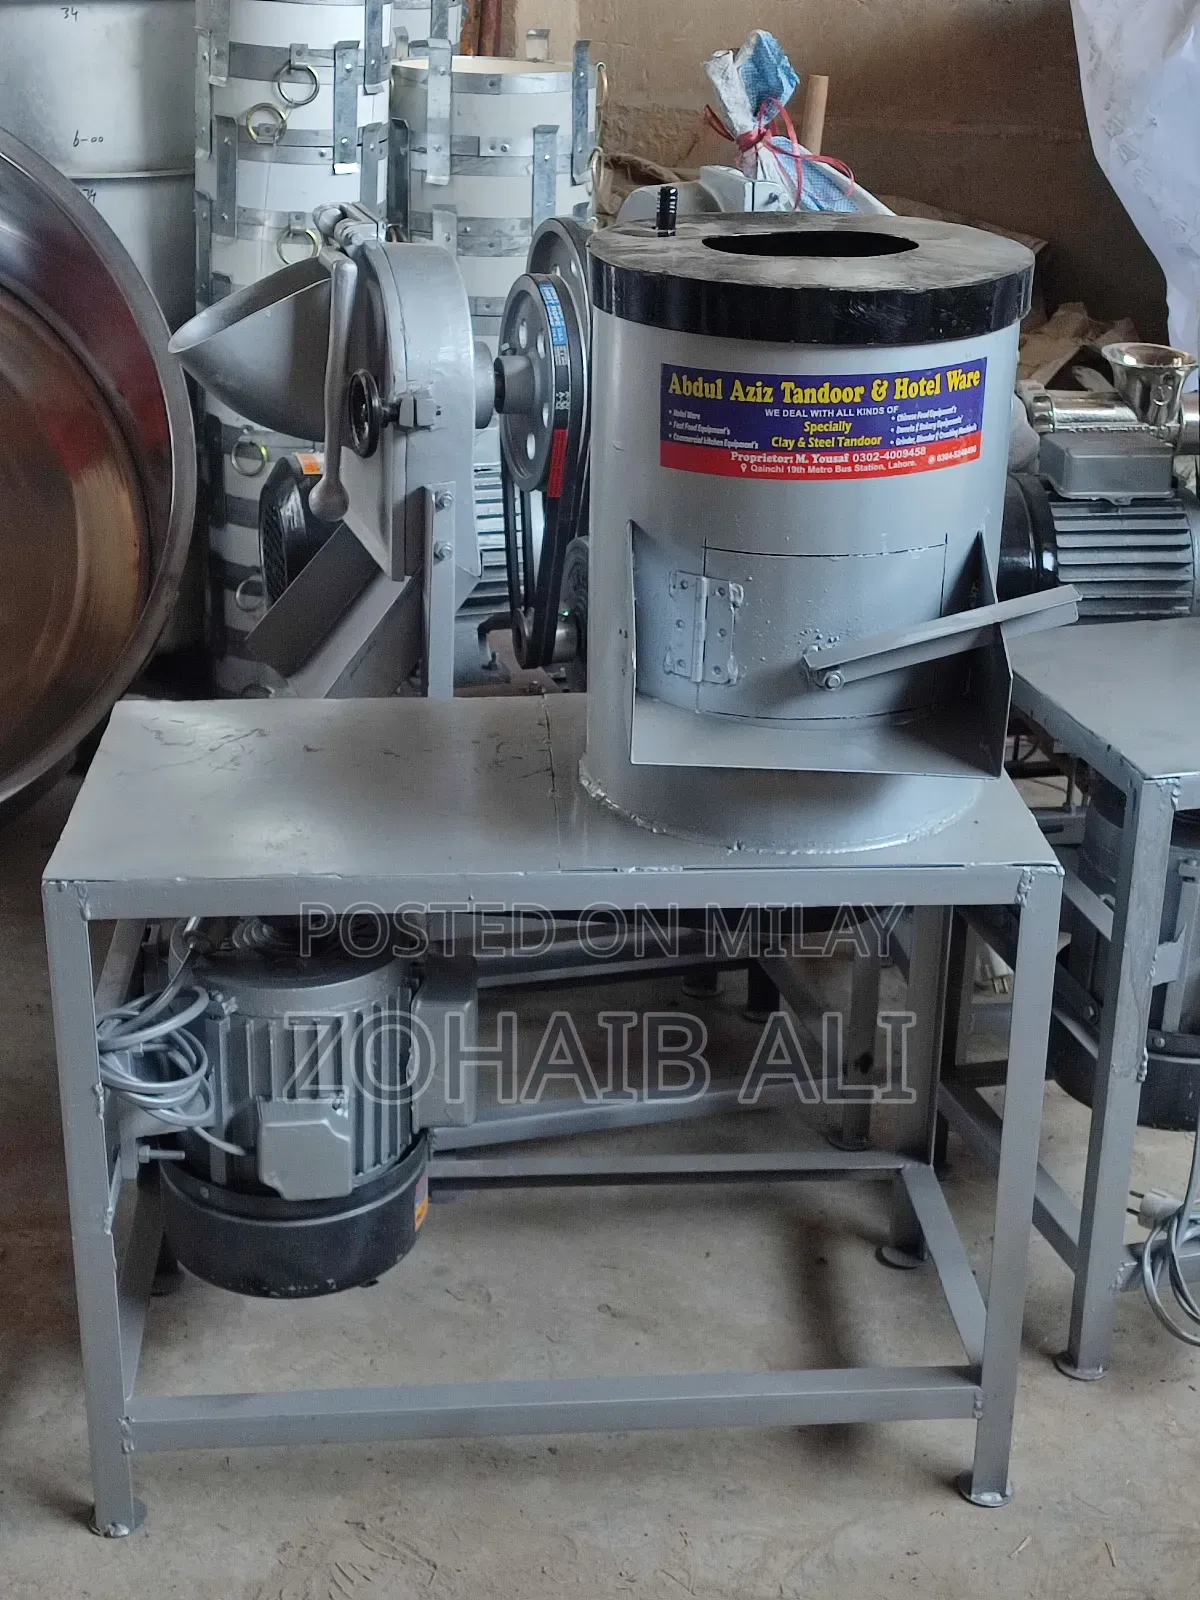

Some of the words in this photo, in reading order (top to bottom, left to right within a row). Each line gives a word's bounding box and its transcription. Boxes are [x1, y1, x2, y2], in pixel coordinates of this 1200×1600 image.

[60, 7, 79, 22] 34
[668, 373, 723, 399] Abdul
[730, 379, 774, 403] Aziz
[781, 382, 865, 405] Tandoor
[871, 379, 889, 402] &
[893, 373, 941, 400] Hotel
[946, 368, 981, 393] Ware
[765, 409, 780, 417] WE
[782, 409, 808, 417] DEAL
[810, 409, 834, 418] WITH
[836, 408, 854, 417] ALL
[856, 406, 885, 416] KINDS
[886, 405, 899, 414] OF
[803, 420, 852, 435] Specially
[771, 436, 795, 450] Clay
[797, 437, 806, 448] &
[808, 436, 835, 448] Steel
[837, 436, 882, 447] Tandoor
[731, 451, 793, 464] Proprietor:
[795, 454, 809, 464] M.
[812, 453, 849, 464] Yousaf
[852, 446, 926, 462] 0302-4009458
[750, 464, 784, 473] Qainchi
[787, 465, 805, 473] 19th
[807, 466, 833, 474] Metro
[835, 465, 852, 473] Bus
[854, 462, 886, 472] Station,
